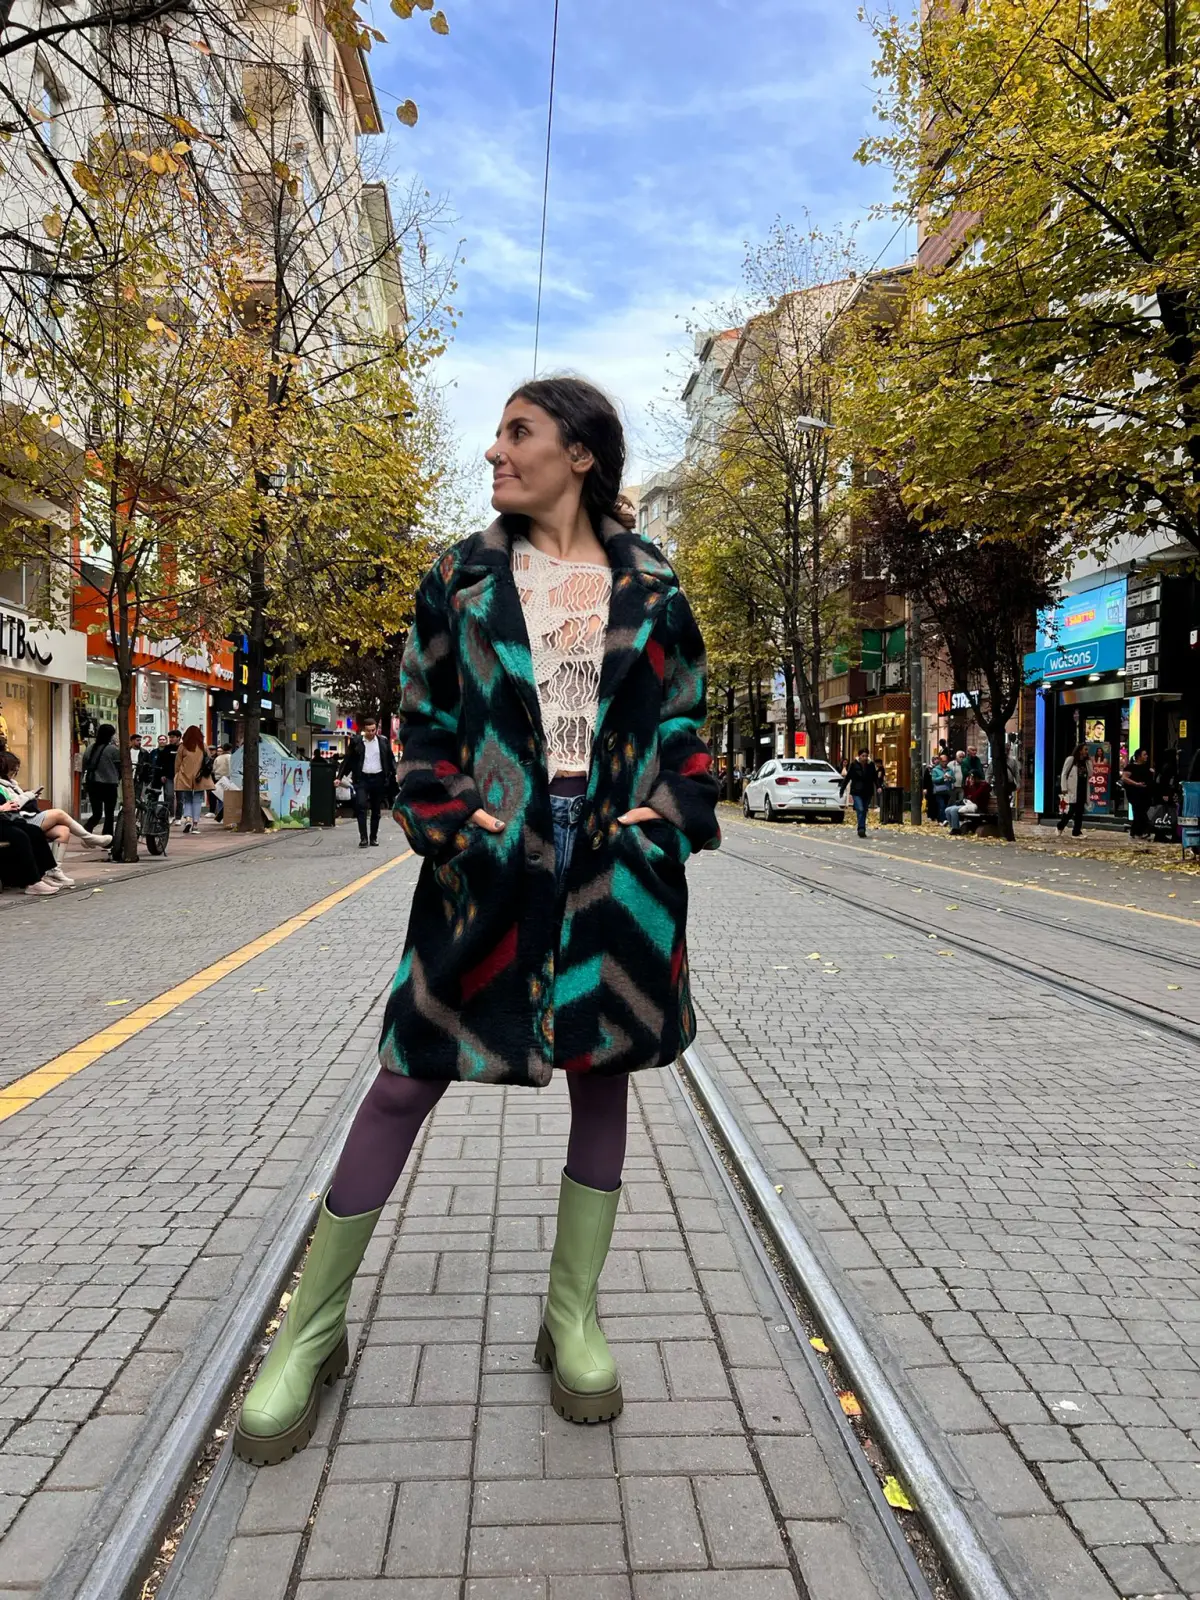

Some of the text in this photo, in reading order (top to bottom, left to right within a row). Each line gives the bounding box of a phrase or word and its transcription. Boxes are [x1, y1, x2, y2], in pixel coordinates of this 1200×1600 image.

[0, 613, 25, 659] LTB
[1050, 651, 1091, 670] watsons
[6, 682, 26, 699] LTB
[938, 690, 979, 715] IN STRET
[1154, 813, 1172, 825] ali
